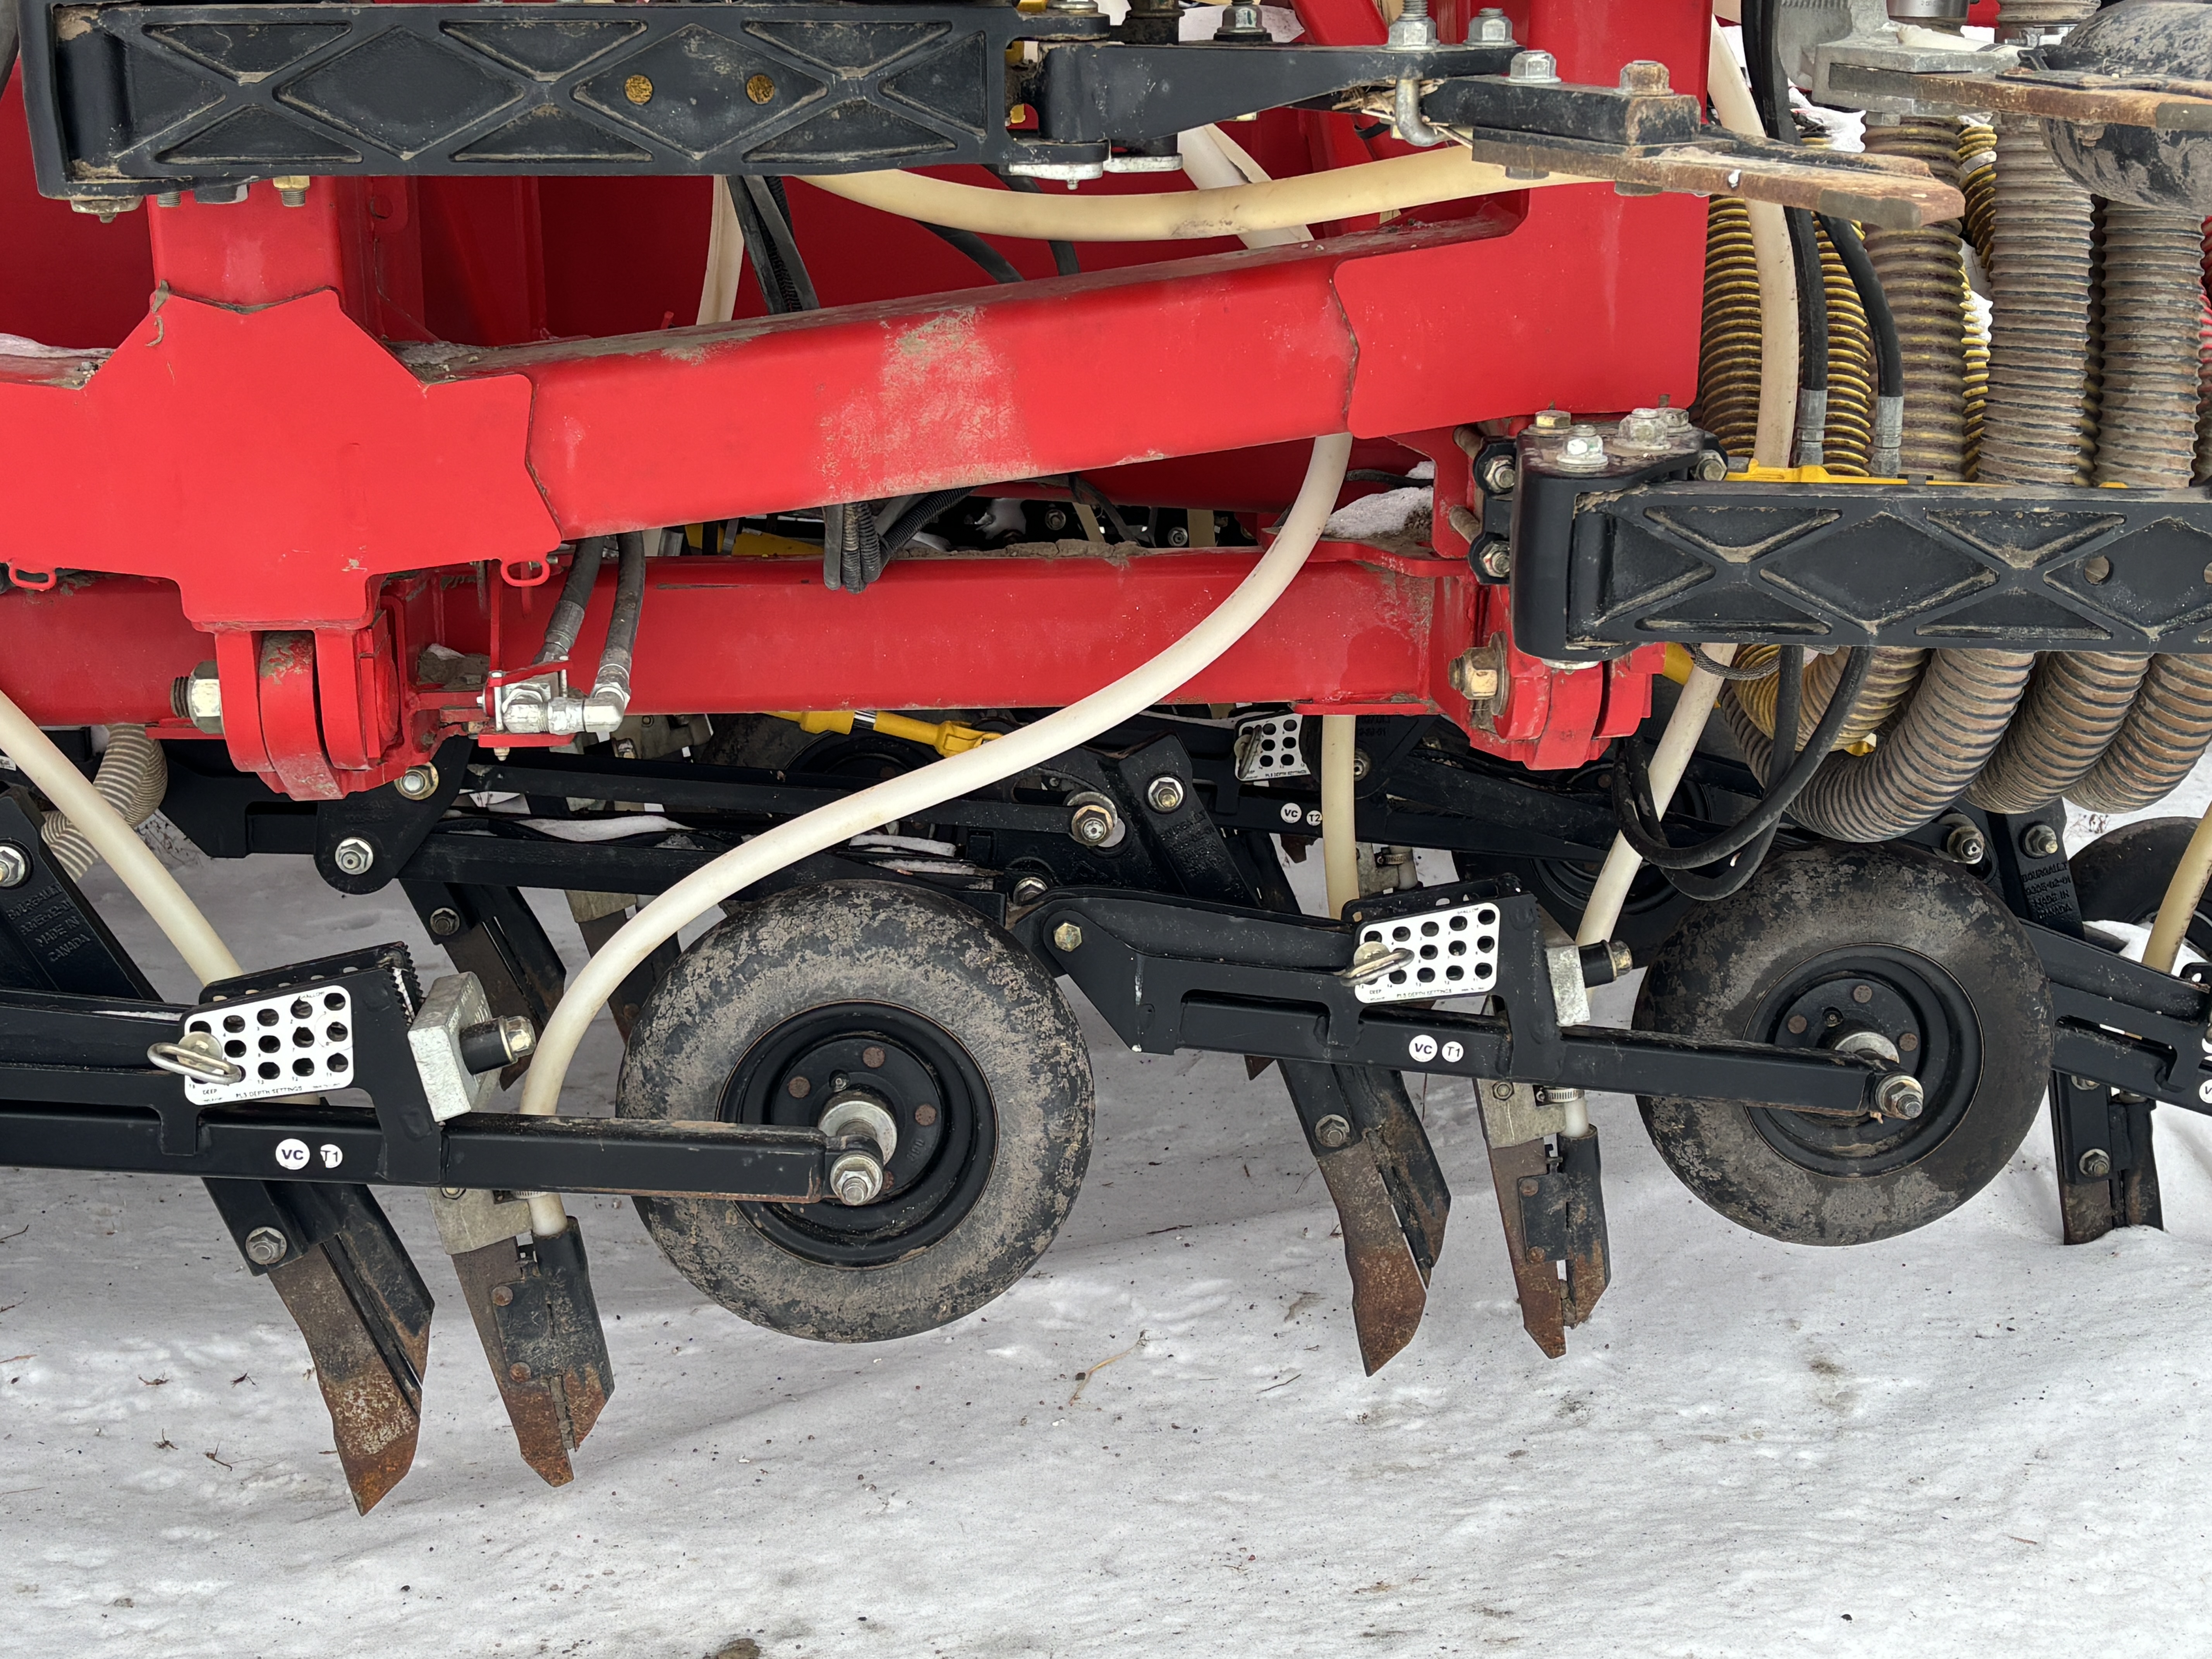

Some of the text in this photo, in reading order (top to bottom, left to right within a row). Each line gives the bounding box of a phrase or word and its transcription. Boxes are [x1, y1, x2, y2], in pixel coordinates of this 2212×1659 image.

[1285, 809, 1298, 817] VC
[1415, 1042, 1432, 1054] VC
[1447, 1046, 1460, 1058] T1
[2205, 1086, 2212, 1095] V
[282, 1149, 304, 1160] VC
[320, 1150, 338, 1163] T1
